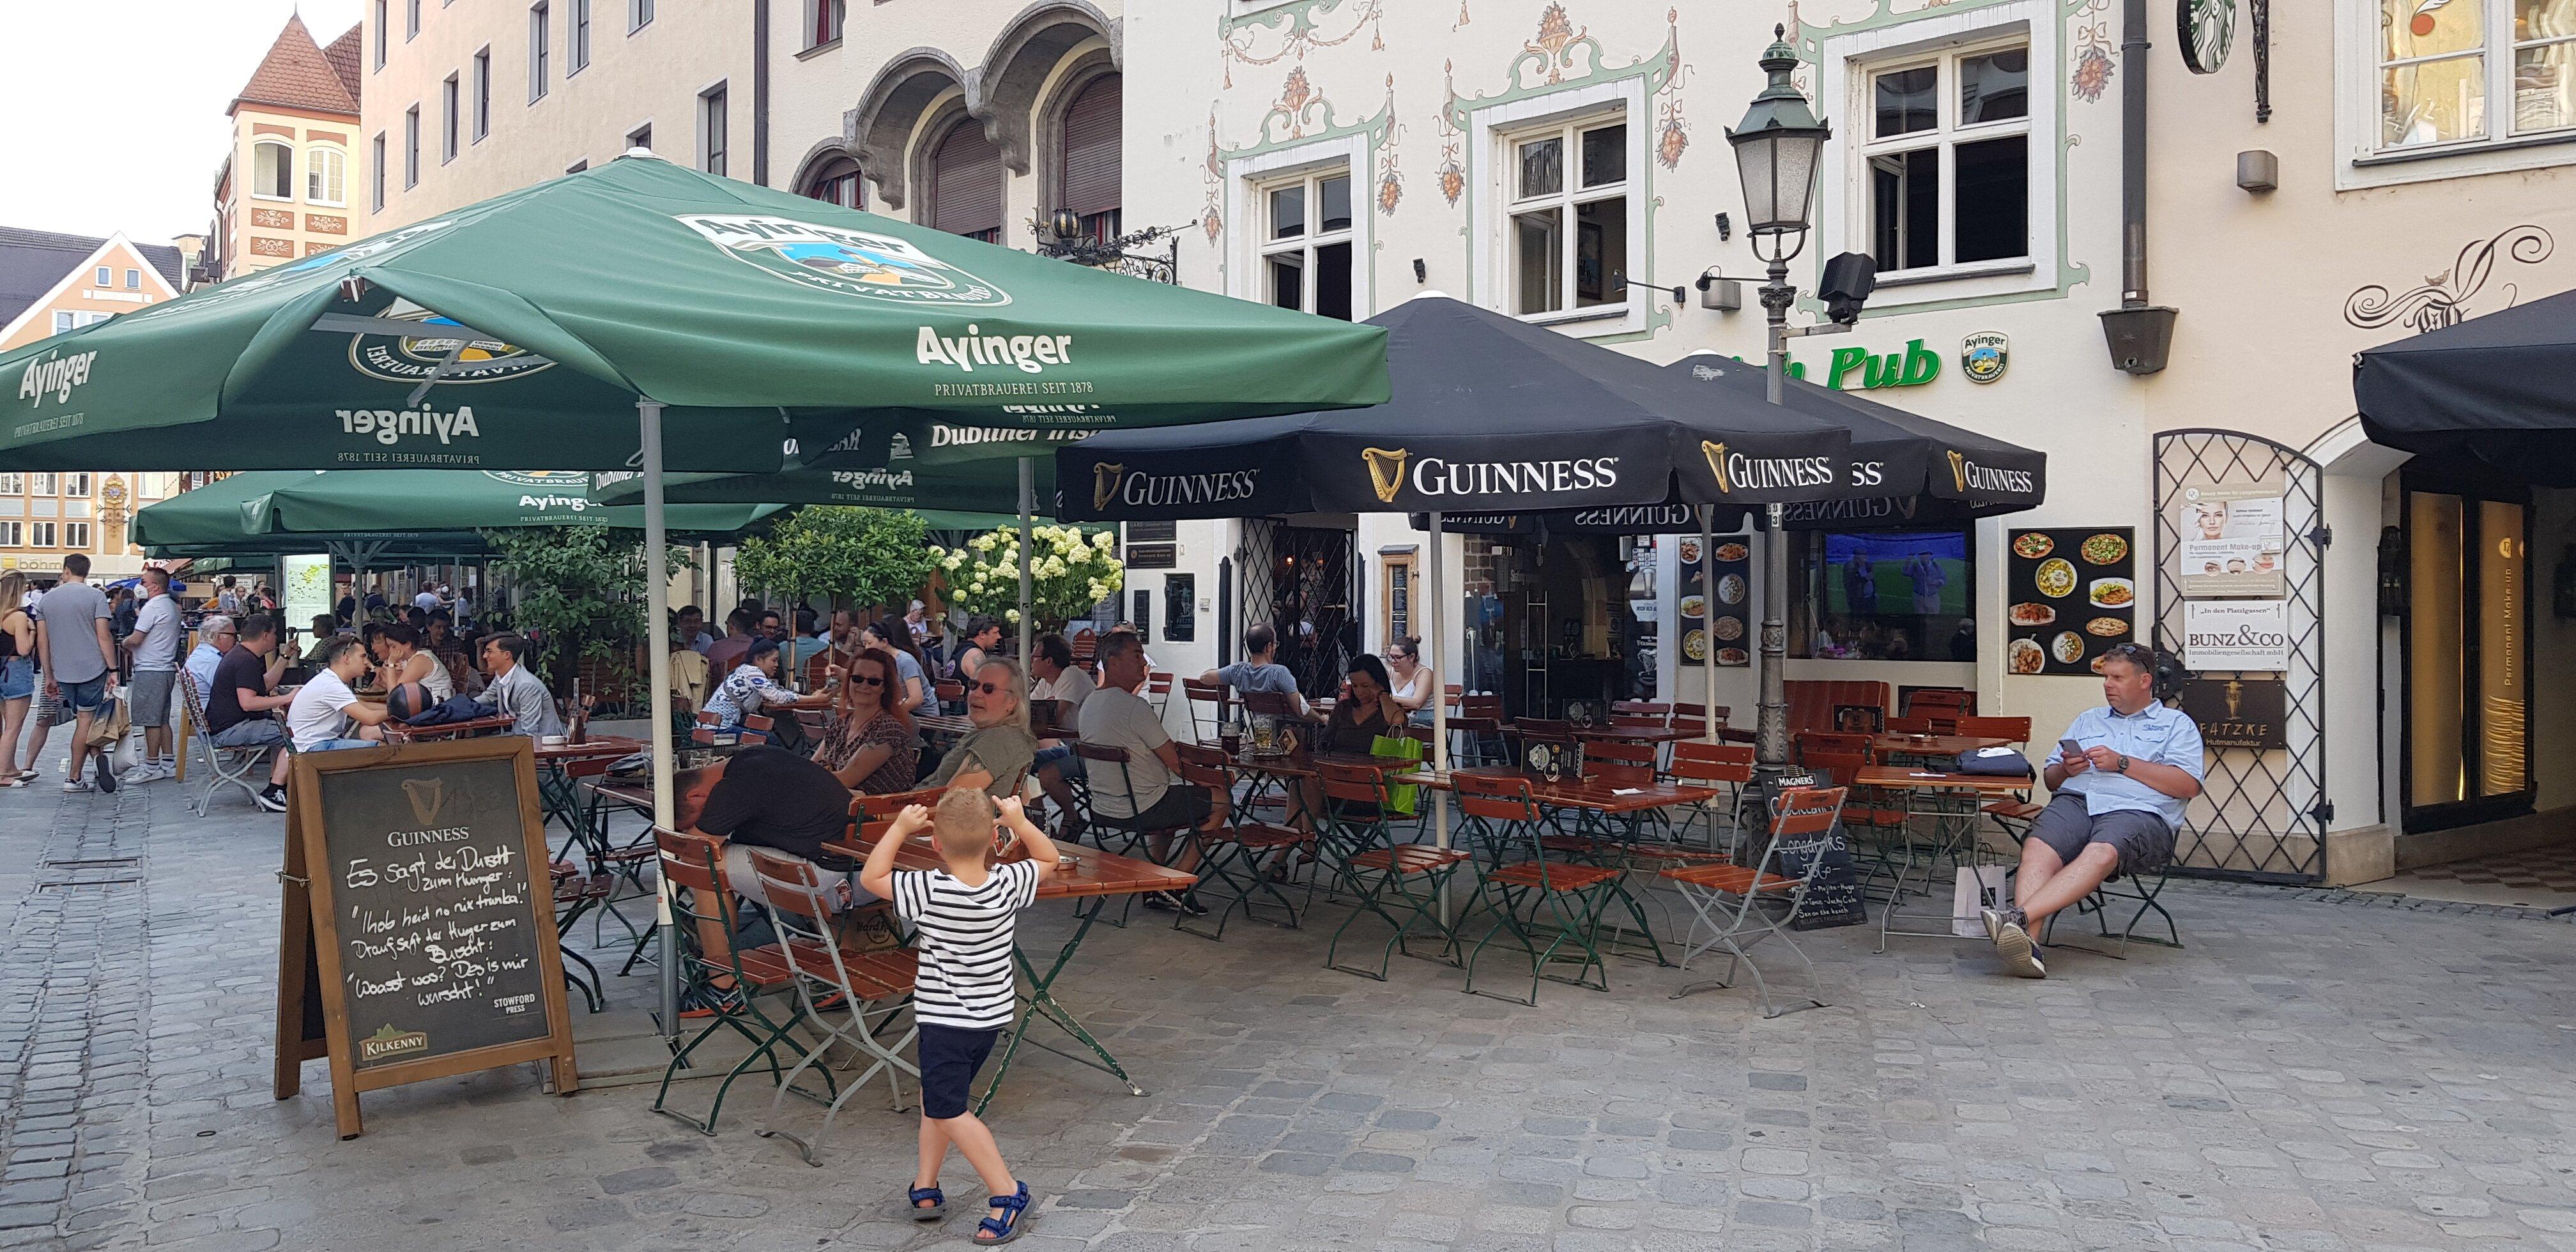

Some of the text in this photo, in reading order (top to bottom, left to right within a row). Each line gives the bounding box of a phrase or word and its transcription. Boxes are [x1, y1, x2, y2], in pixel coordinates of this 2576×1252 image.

[695, 219, 905, 253] Ayinger
[917, 323, 1071, 374] Ayinger
[1965, 335, 2005, 349] Ayinger
[1827, 339, 1942, 391] Pub
[20, 349, 98, 409] Ayinger
[935, 381, 1093, 395] PRIVATBRAUEREI SEIT 1878
[1413, 457, 1618, 495] GUINNESS
[1728, 452, 1833, 489] GUINNESS
[1965, 461, 2033, 493] GUINNESS
[1123, 468, 1257, 506] GUINNESS
[1772, 515, 1778, 524] 3
[2205, 738, 2262, 747] Hutmanufaktur
[1778, 775, 1814, 787] MAGNERS
[387, 827, 469, 848] GUINNESS
[346, 859, 378, 889] Es
[435, 850, 456, 871] der
[422, 876, 452, 891] zum
[402, 905, 430, 928] heid
[434, 907, 450, 917] no
[454, 897, 475, 912] nix
[425, 928, 441, 942] der
[489, 918, 516, 931] zum
[451, 960, 485, 979] Des
[486, 956, 499, 973] is
[503, 953, 528, 971] mir
[494, 993, 535, 1009] STOWFORD
[505, 1004, 525, 1014] PRESS
[366, 1036, 424, 1056] KILKENNY
